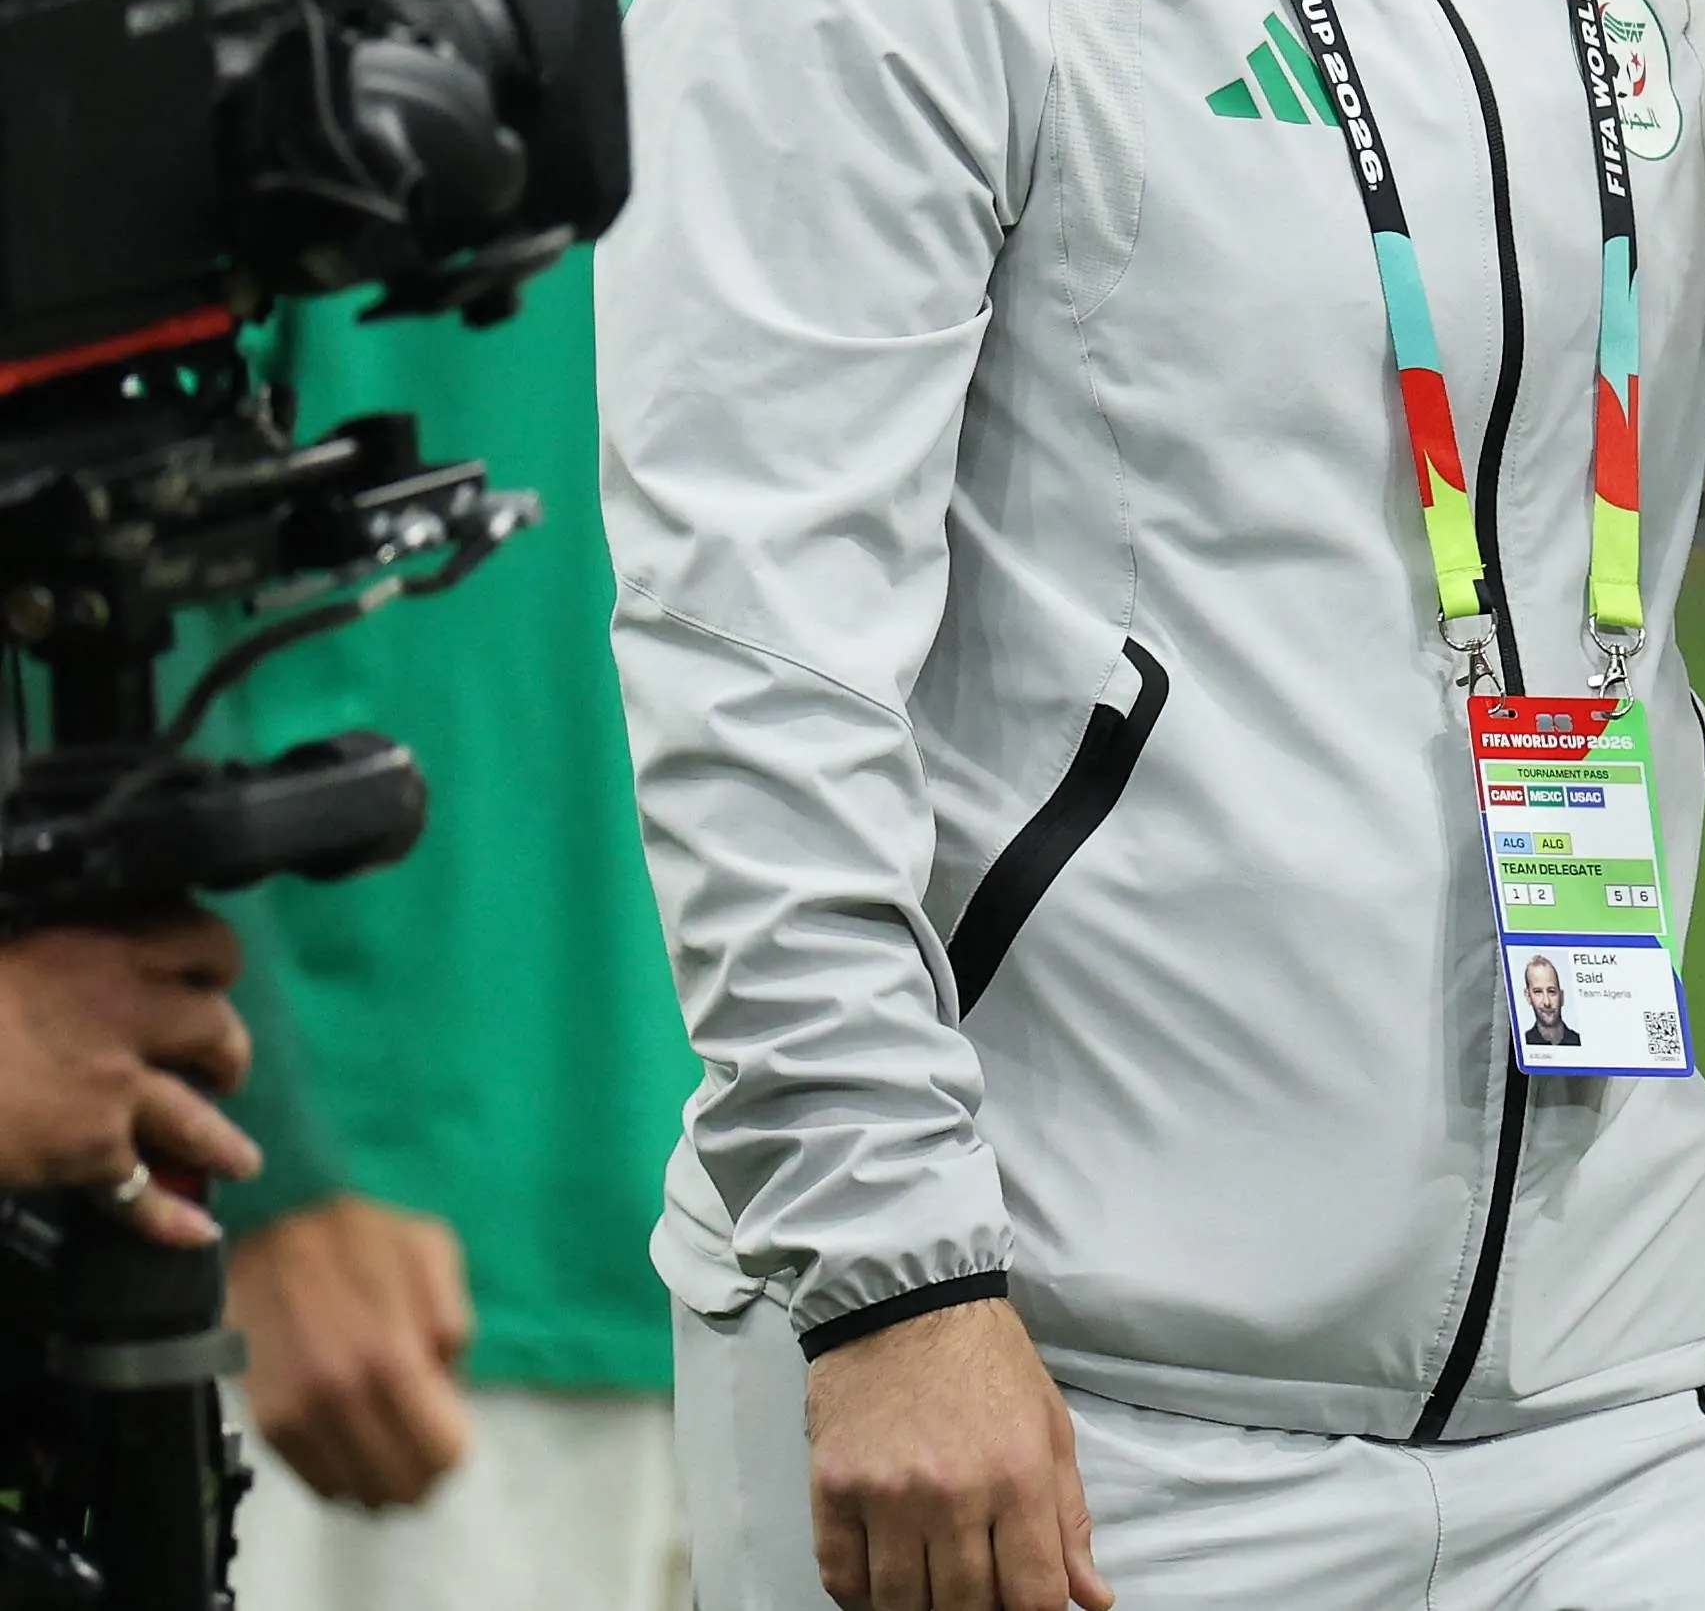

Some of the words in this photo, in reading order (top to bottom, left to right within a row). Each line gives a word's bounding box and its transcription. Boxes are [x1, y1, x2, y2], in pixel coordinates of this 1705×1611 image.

[1322, 52, 1385, 188] 2026
[1600, 117, 1626, 197] FIFA
[1482, 733, 1511, 747] FIFA
[1511, 734, 1559, 749] WORLD
[1559, 735, 1586, 749] CUP
[1587, 736, 1633, 750] 2026
[1518, 768, 1581, 779] TOURNAMENT
[1583, 770, 1609, 780] PASS
[1491, 791, 1523, 801] CANC
[1530, 791, 1563, 802] MEXC
[1569, 792, 1602, 802] USAC
[1503, 838, 1525, 848] ALG
[1542, 839, 1564, 849] ALG
[1502, 863, 1537, 875] TEAM
[1539, 864, 1602, 876] DELEGATE
[1573, 954, 1617, 965] FELLAK
[1575, 972, 1604, 984] Said
